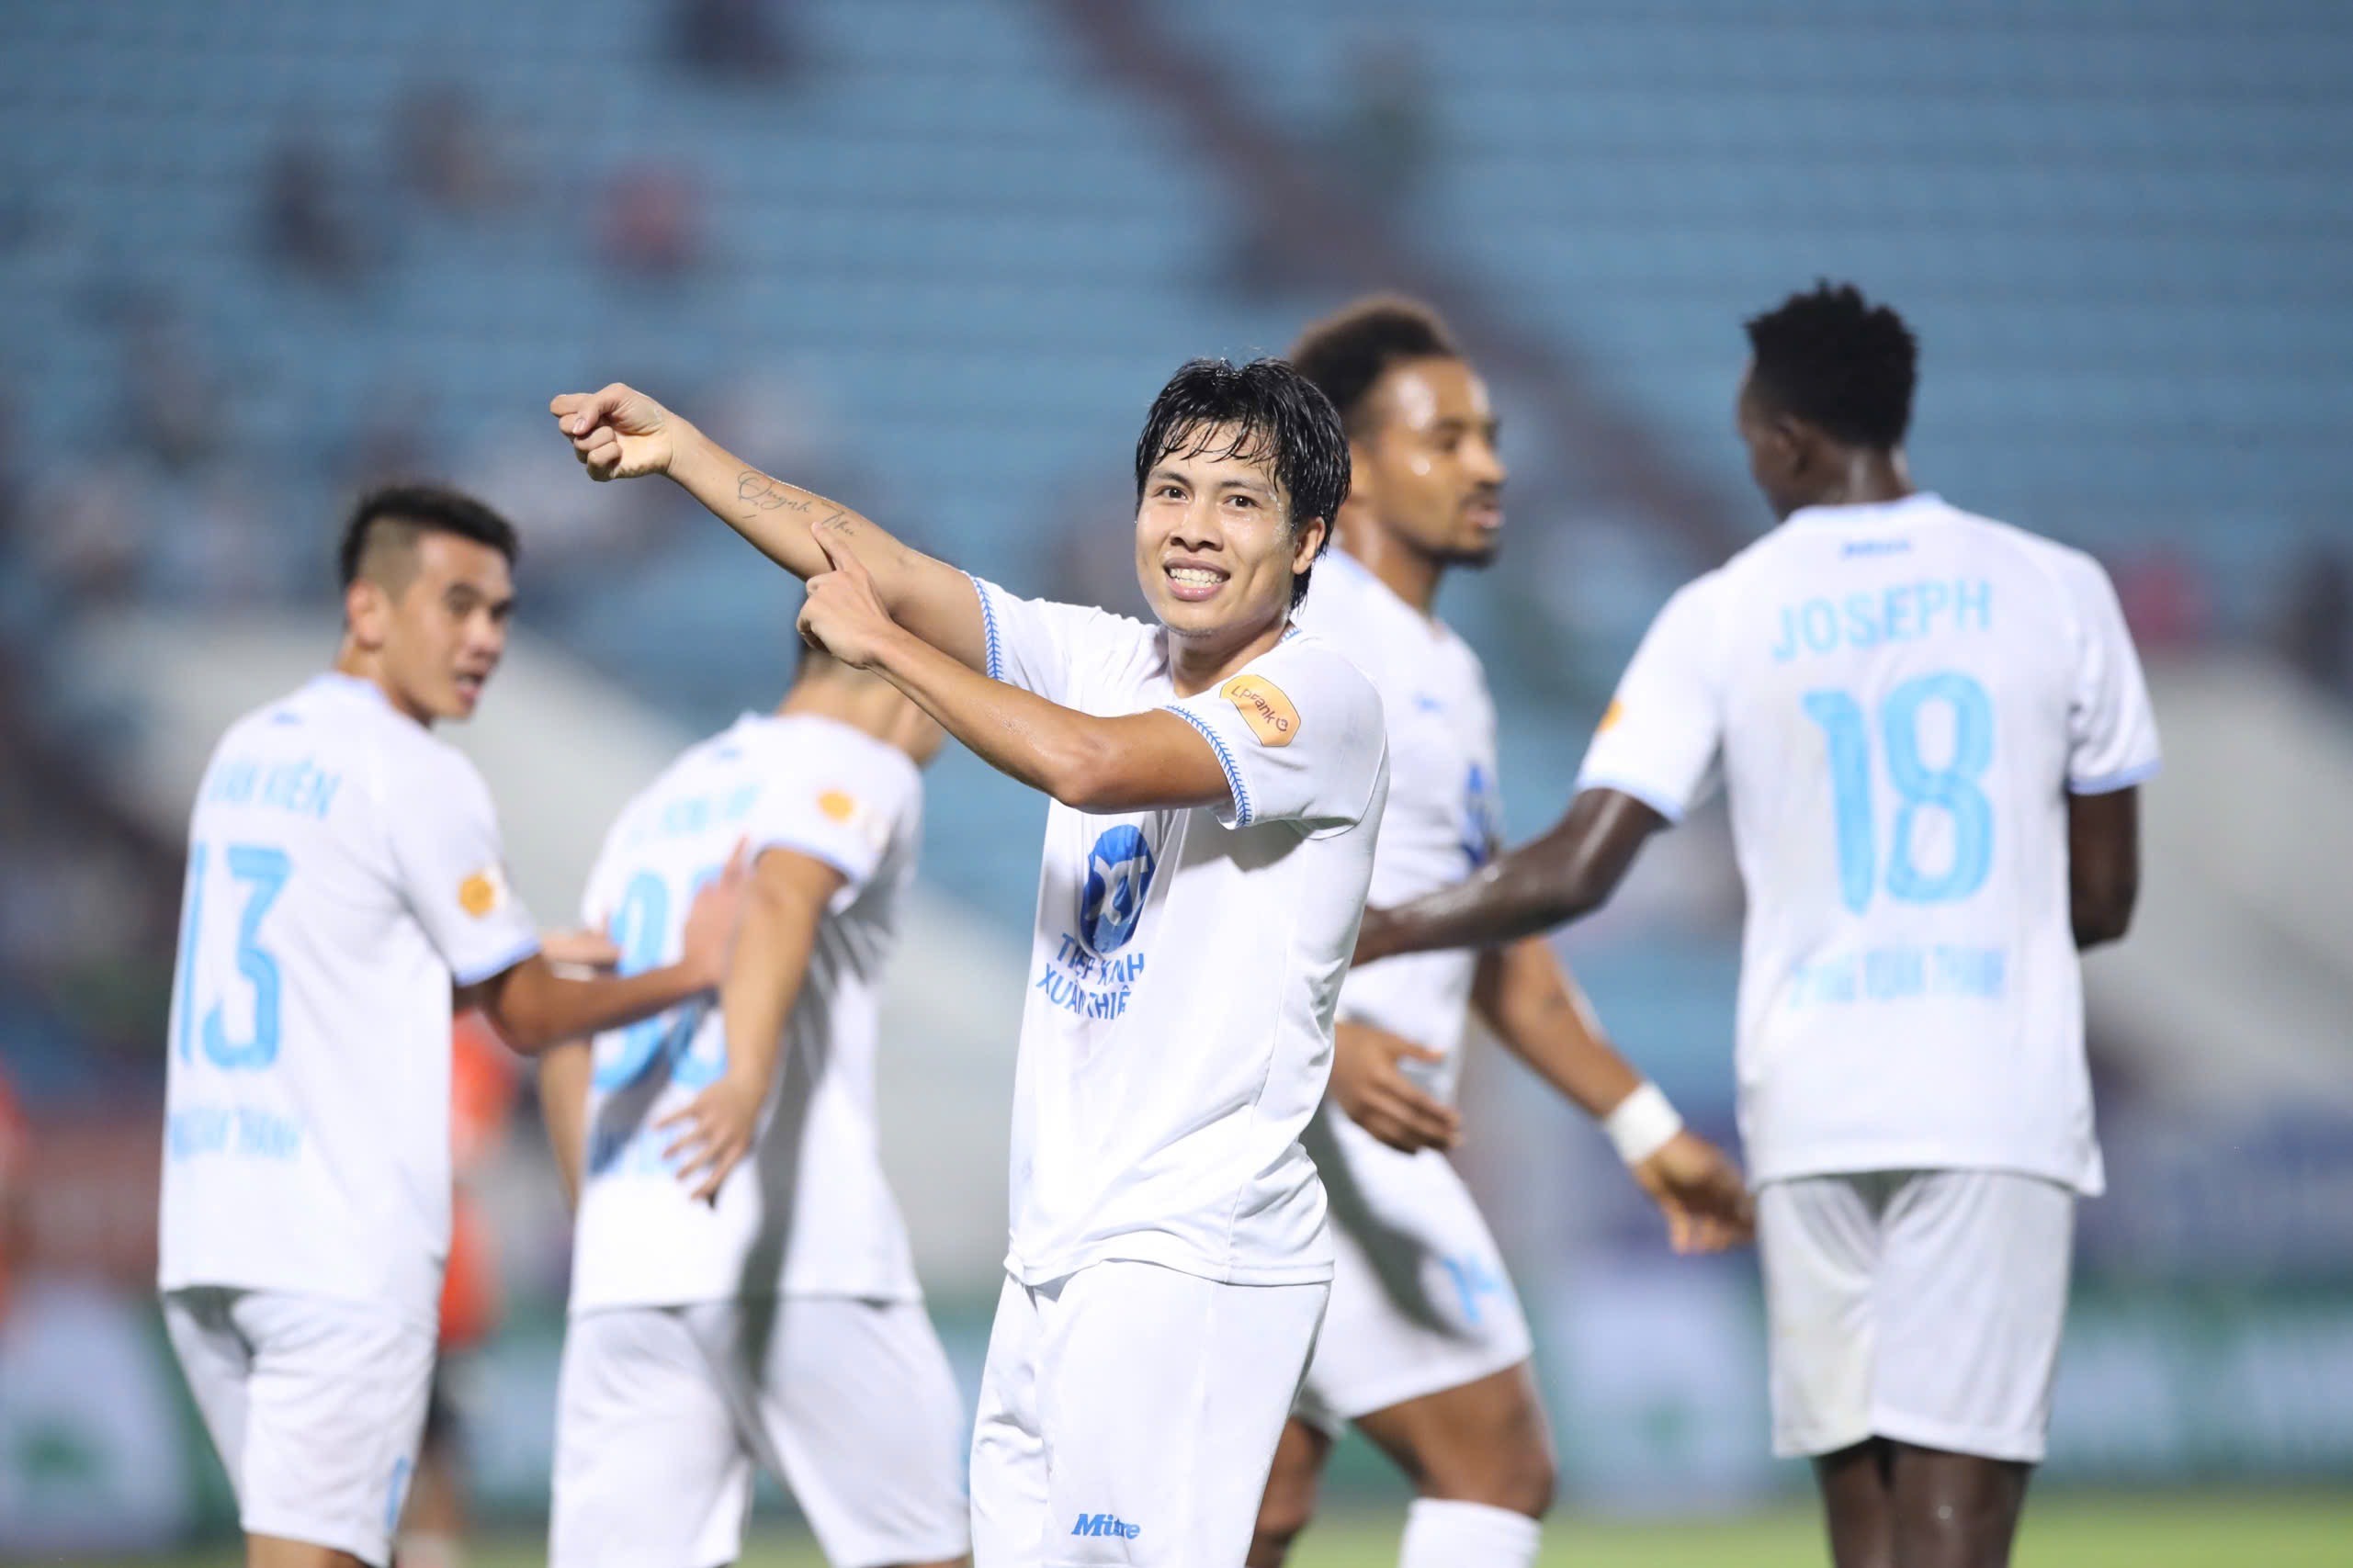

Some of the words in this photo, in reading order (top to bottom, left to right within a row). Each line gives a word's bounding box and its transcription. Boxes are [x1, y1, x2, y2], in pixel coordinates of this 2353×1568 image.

[1772, 580, 1993, 662] JOSEPH
[1801, 671, 1996, 917] 18
[180, 840, 292, 1071] 13
[1071, 1513, 1141, 1540] Mitre
